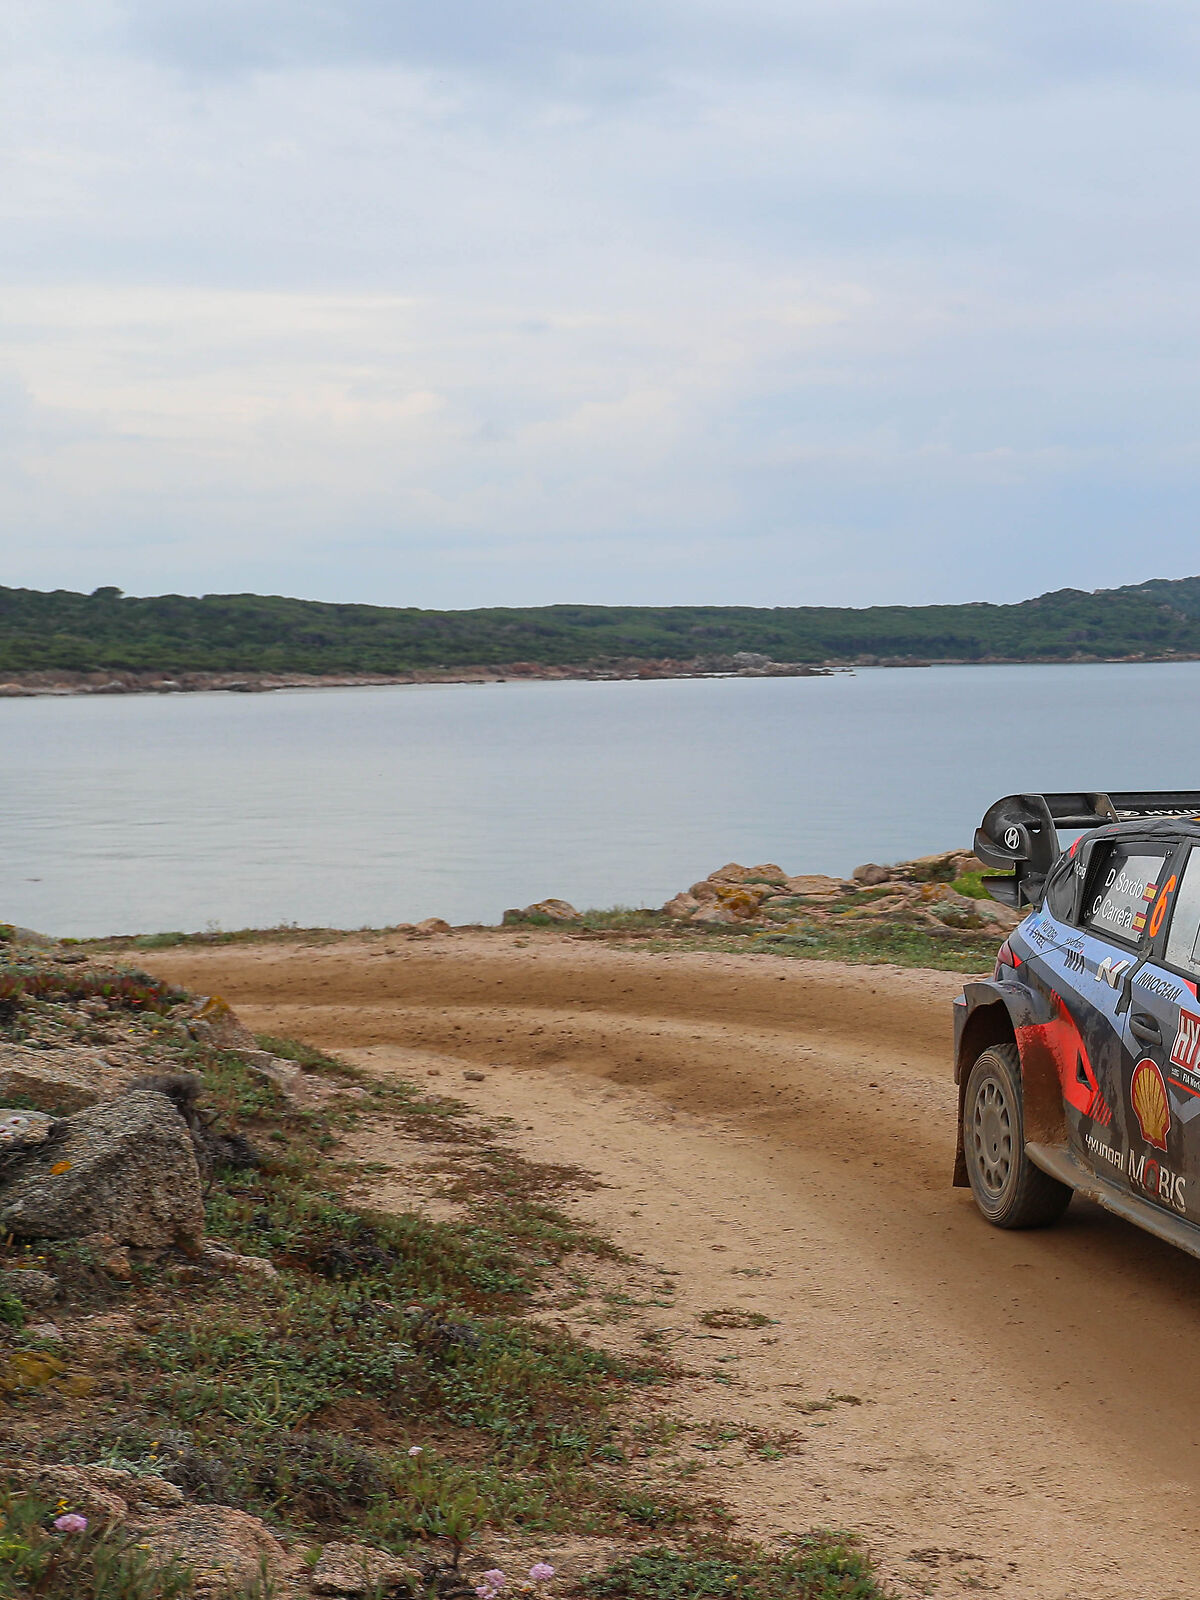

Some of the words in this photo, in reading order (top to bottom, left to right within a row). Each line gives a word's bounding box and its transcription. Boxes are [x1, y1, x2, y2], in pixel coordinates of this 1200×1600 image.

[1116, 872, 1143, 898] Sordo
[1101, 899, 1133, 929] Carrera
[1149, 874, 1177, 938] 6
[1063, 949, 1086, 975] WIA
[1136, 971, 1183, 1002] INNOCEAN
[1172, 1015, 1200, 1065] HY
[1182, 1073, 1190, 1085] FIA
[1085, 1133, 1124, 1171] HYUNDAI
[1128, 1148, 1187, 1213] MOBIS
